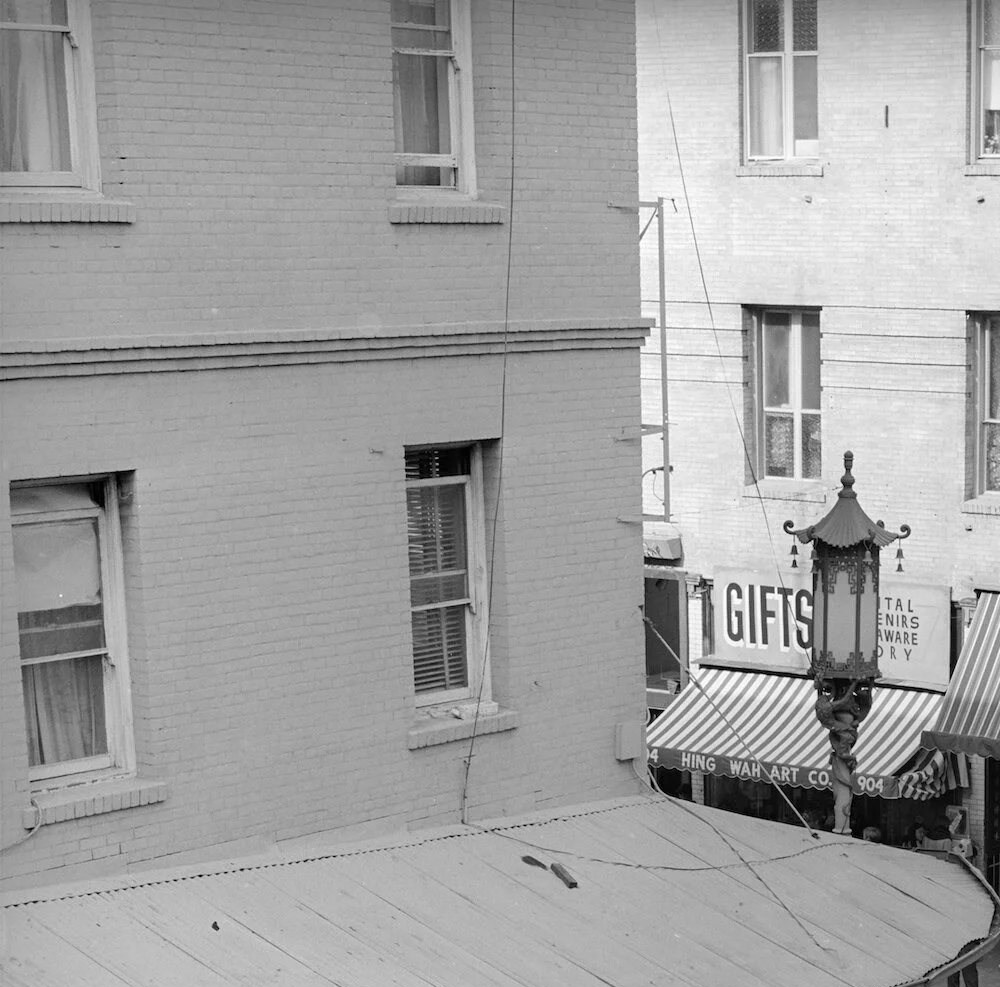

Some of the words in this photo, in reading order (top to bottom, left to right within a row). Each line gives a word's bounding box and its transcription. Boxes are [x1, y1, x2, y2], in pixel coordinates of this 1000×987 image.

[726, 582, 813, 650] GIFTS
[879, 597, 914, 612] TAL
[681, 752, 717, 771] HING
[729, 760, 761, 778] WAH
[770, 764, 800, 783] ART
[808, 770, 832, 787] CO.
[857, 775, 885, 793] 904
